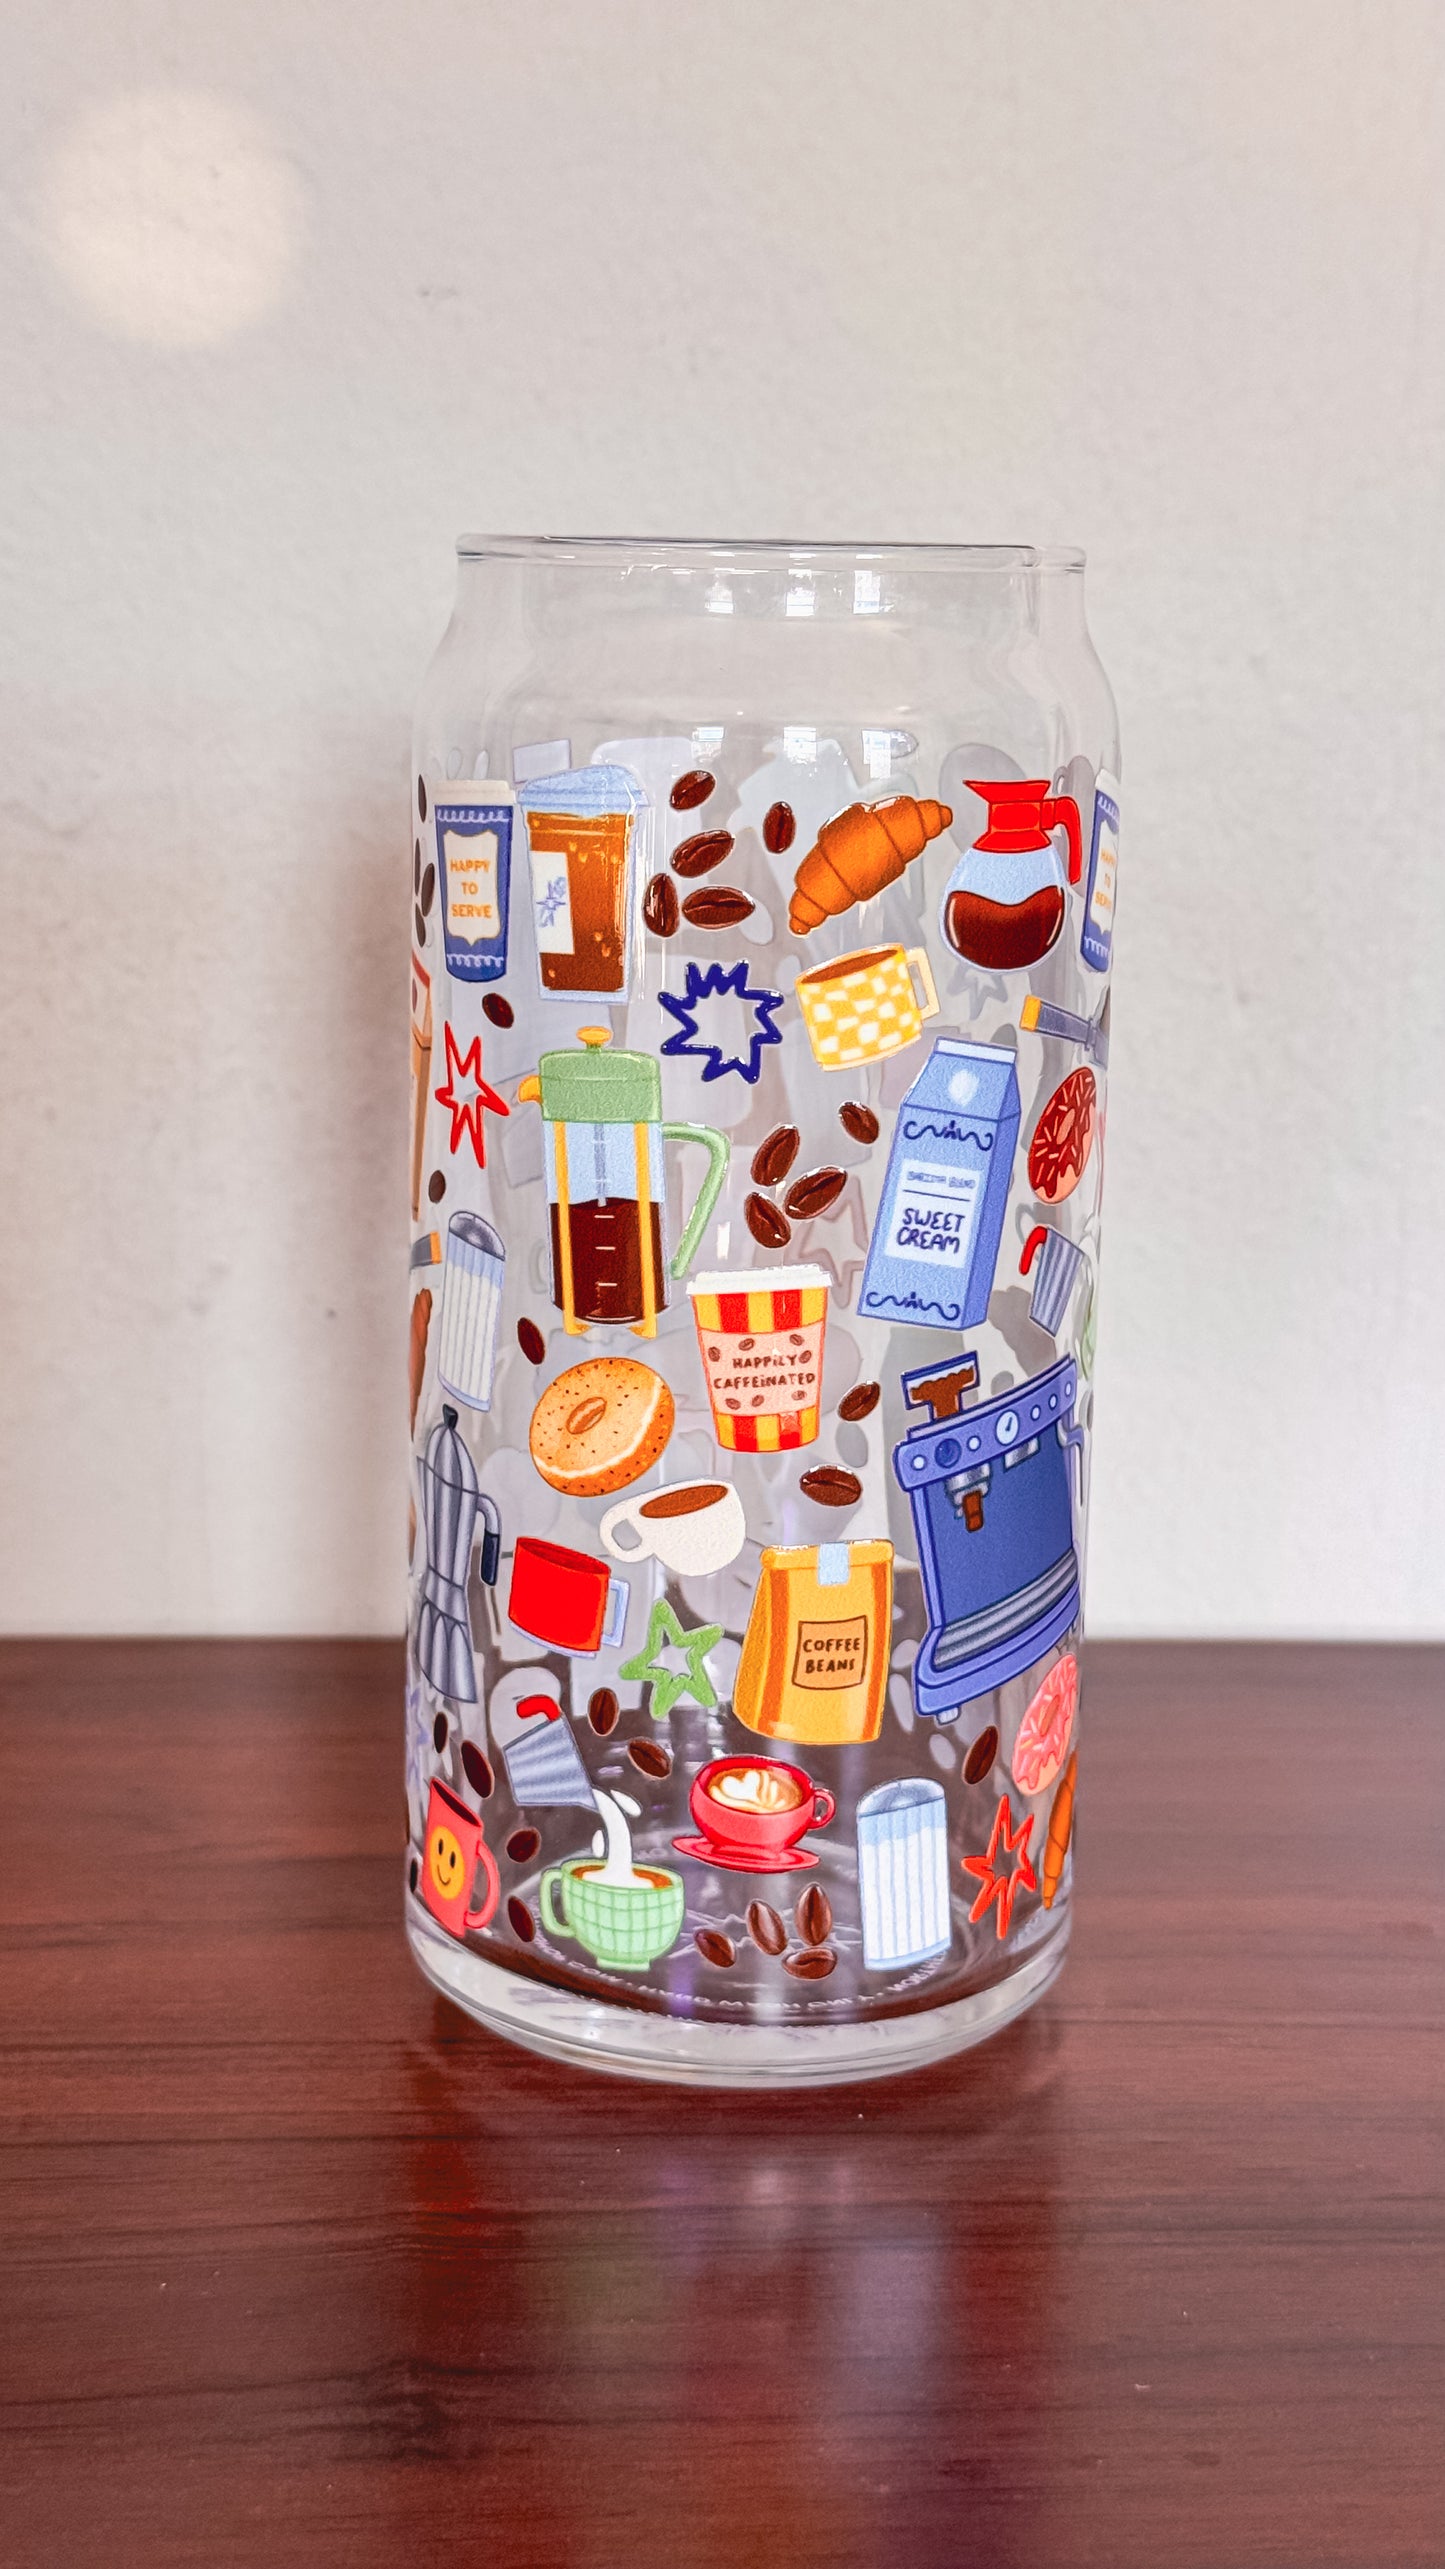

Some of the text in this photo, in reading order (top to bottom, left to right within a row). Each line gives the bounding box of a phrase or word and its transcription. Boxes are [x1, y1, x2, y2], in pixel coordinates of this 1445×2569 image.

[450, 857, 490, 873] HAPPY
[461, 881, 479, 895] TO
[451, 903, 492, 919] SERVE
[902, 1208, 966, 1233] SWEET
[897, 1226, 960, 1255] CREAM
[803, 1637, 860, 1653] COFFEE
[805, 1658, 855, 1674] BEANS
